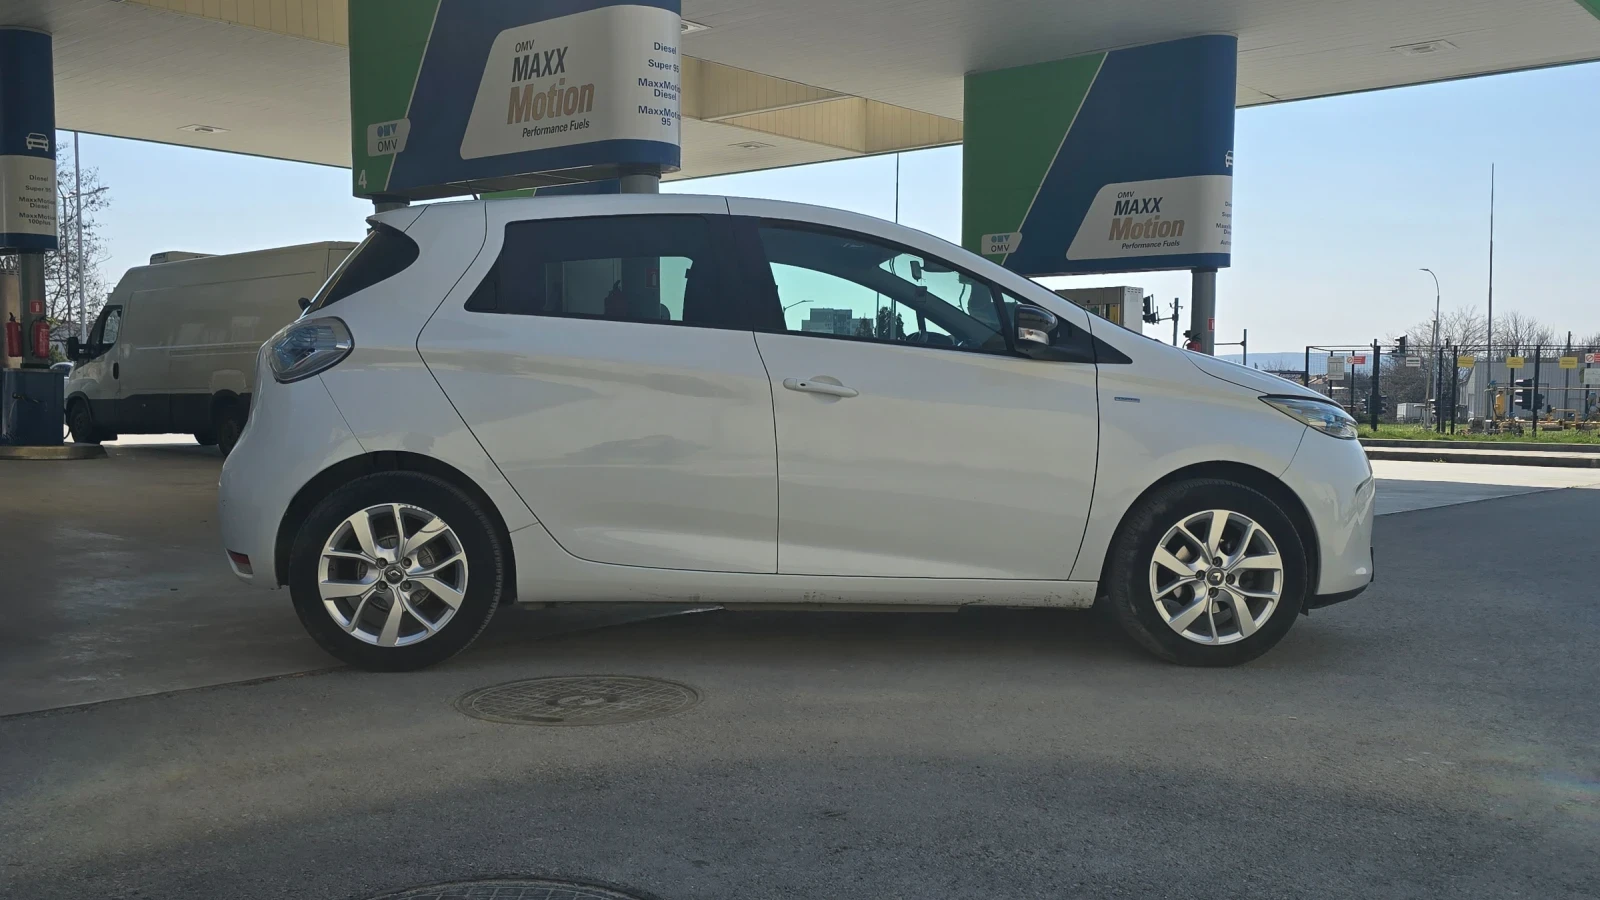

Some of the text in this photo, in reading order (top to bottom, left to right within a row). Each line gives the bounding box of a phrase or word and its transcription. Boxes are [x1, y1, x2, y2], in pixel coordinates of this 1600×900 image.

[515, 39, 535, 53] OMV
[653, 42, 677, 55] Diesel
[512, 46, 568, 83] MAXX
[648, 59, 680, 74] Super 95
[507, 78, 595, 125] Motion
[653, 88, 677, 101] Diesel
[522, 118, 590, 138] Performance Fuels
[661, 117, 671, 127] 95
[377, 138, 398, 152] OMV
[358, 169, 367, 189] 4
[1117, 191, 1135, 199] OMV
[1113, 197, 1163, 216] MAXX
[1108, 215, 1185, 241] Motion
[990, 244, 1010, 252] OMV
[1122, 241, 1161, 250] Performance
